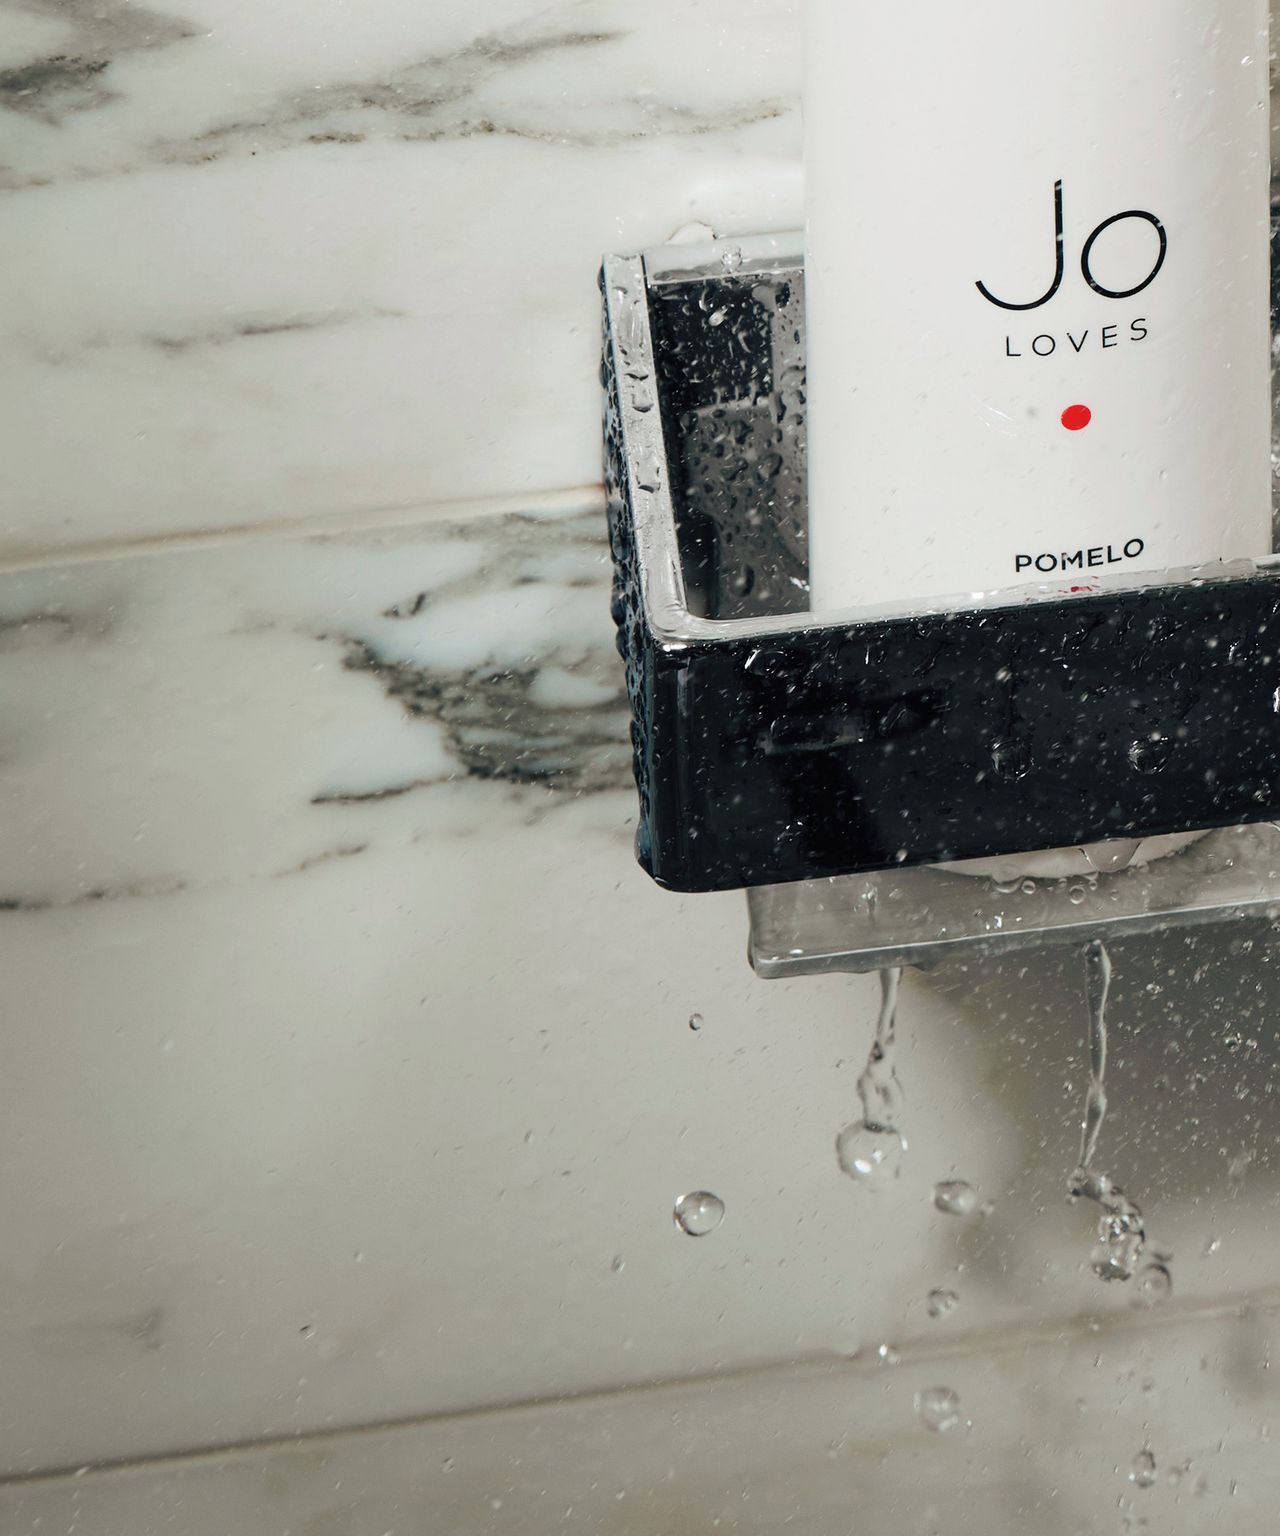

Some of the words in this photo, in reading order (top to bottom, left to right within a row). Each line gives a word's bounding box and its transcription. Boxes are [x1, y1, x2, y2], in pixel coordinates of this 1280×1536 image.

[975, 179, 1167, 310] Jo
[1006, 318, 1148, 357] LOVES
[1015, 538, 1144, 572] POMELO
